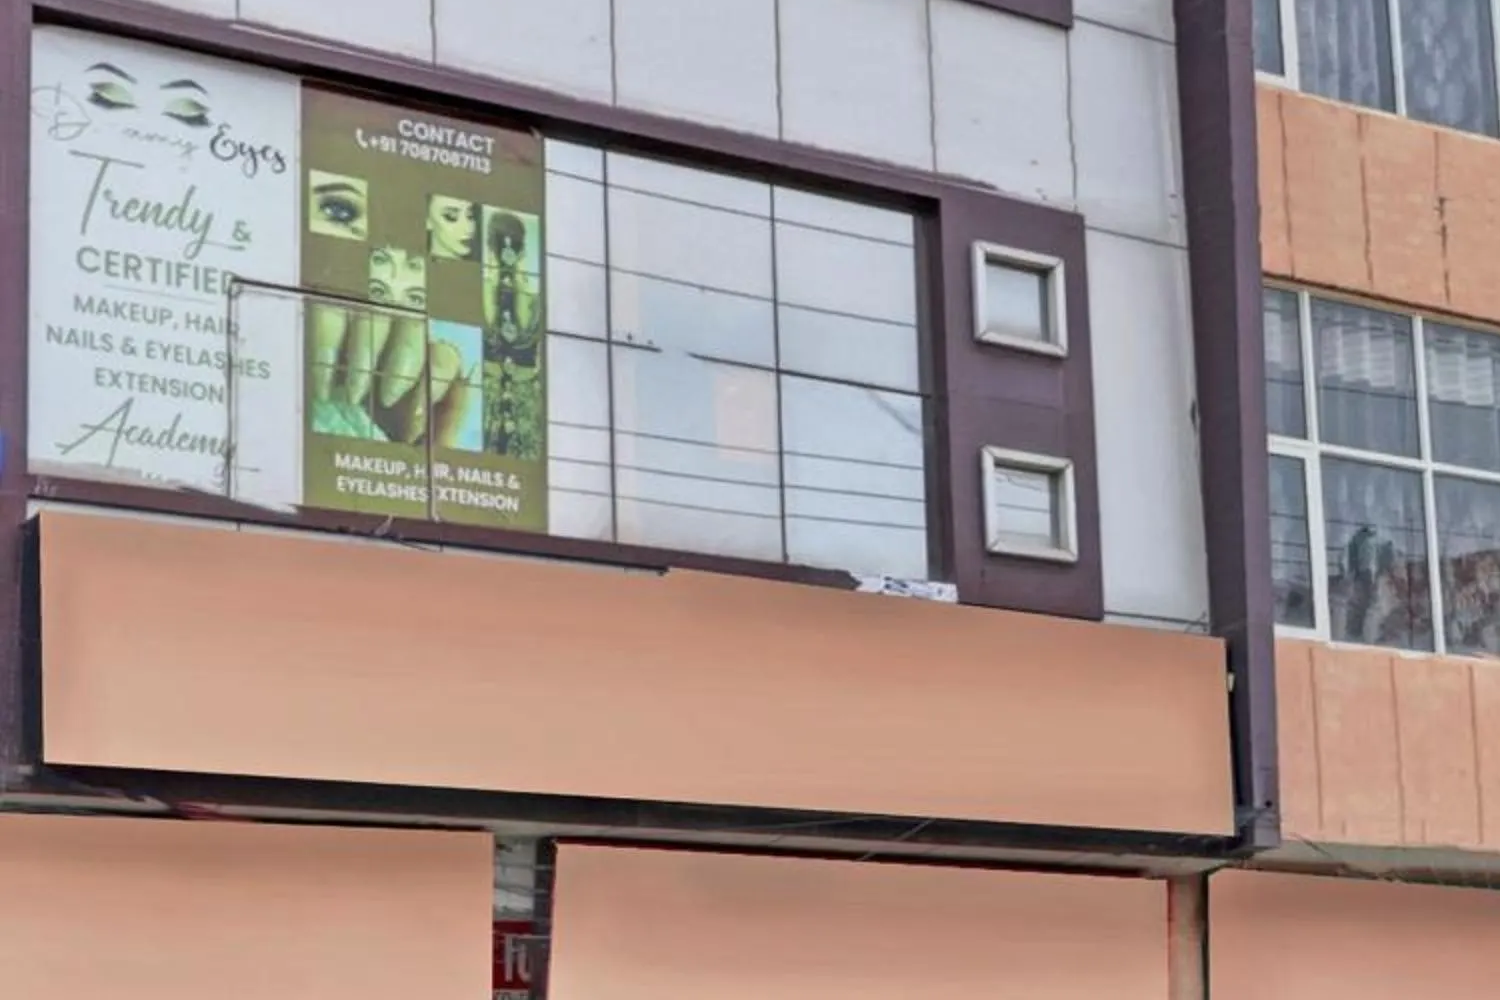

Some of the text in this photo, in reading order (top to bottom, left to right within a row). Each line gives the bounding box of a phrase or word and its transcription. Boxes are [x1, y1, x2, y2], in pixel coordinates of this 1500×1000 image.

[209, 122, 287, 180] Eyes
[398, 118, 496, 156] CONTACT
[68, 149, 253, 261] Trendy &
[76, 246, 243, 299] CERTIFIED
[73, 294, 180, 332] MAKEUP,
[46, 324, 272, 380] NAILS & EYELASHES
[94, 366, 225, 405] EXTENSION
[54, 396, 263, 482] Academy
[457, 467, 504, 489] NAILS
